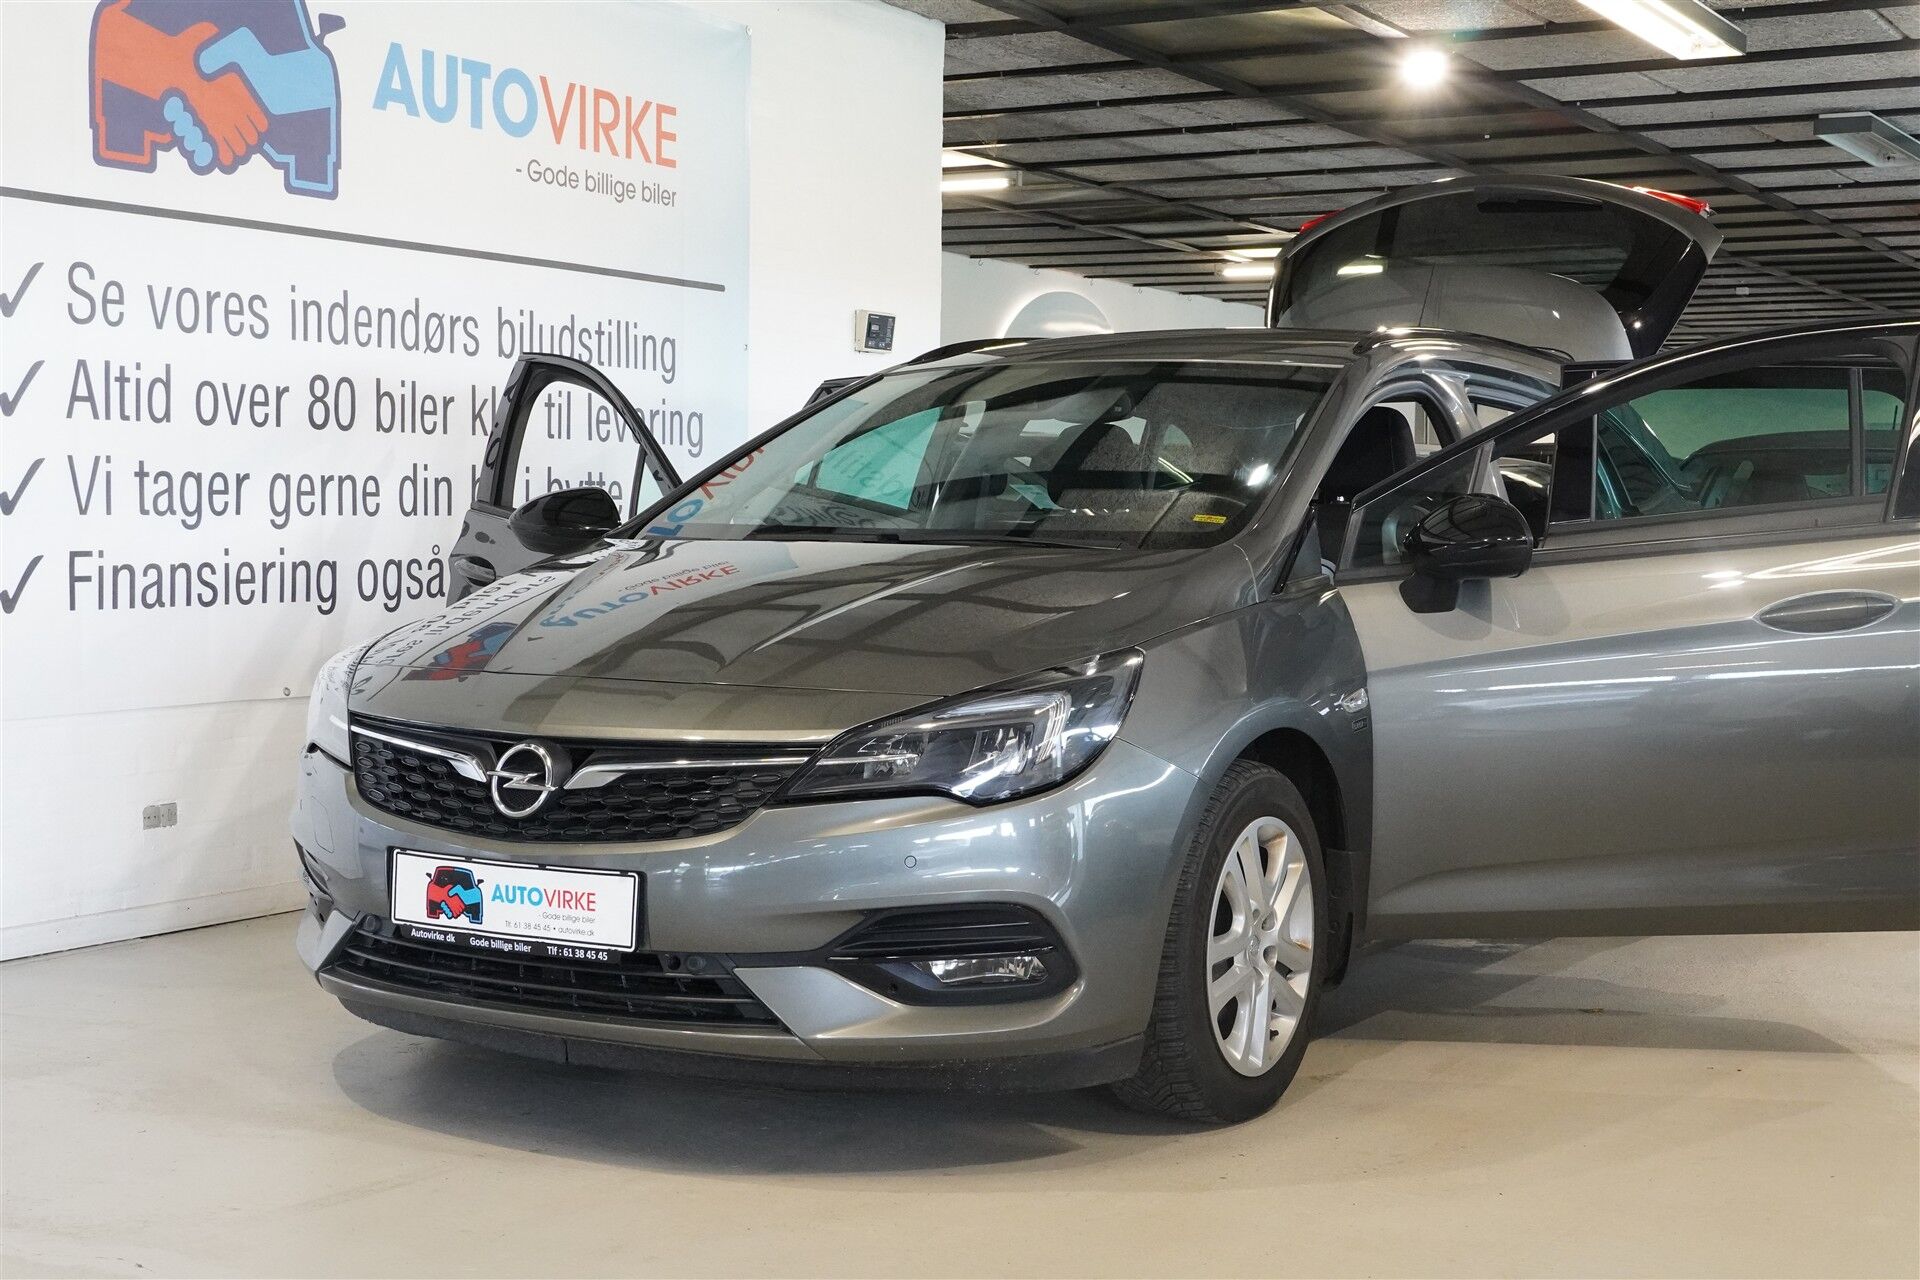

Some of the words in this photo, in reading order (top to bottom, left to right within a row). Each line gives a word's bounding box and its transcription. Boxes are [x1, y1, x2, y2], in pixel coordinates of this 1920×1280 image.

[372, 41, 677, 169] AUTOVIRKE
[527, 159, 580, 189] Gode
[585, 170, 636, 203] billige
[641, 180, 677, 207] biler
[67, 261, 125, 328] Se
[147, 284, 270, 340] vores
[290, 284, 480, 357] indendørs
[498, 306, 676, 385] biludstilling
[66, 359, 172, 424] Altid
[195, 380, 290, 428] over
[307, 374, 356, 432] 80
[375, 377, 455, 435] biler
[544, 390, 572, 440] til
[67, 454, 112, 516] Vi
[134, 460, 250, 530] tager
[269, 472, 381, 530] gerne
[399, 463, 453, 517] din
[68, 547, 338, 616] Finansiering
[357, 544, 446, 613] også
[491, 884, 596, 912] AUTOVIRKE
[411, 928, 445, 941] Autovirke
[469, 936, 490, 947] Gode
[491, 939, 513, 952] billige
[514, 941, 532, 953] biler
[563, 947, 573, 957] 61
[575, 949, 585, 959] 38
[586, 950, 596, 960] 45
[597, 951, 608, 961] 45
